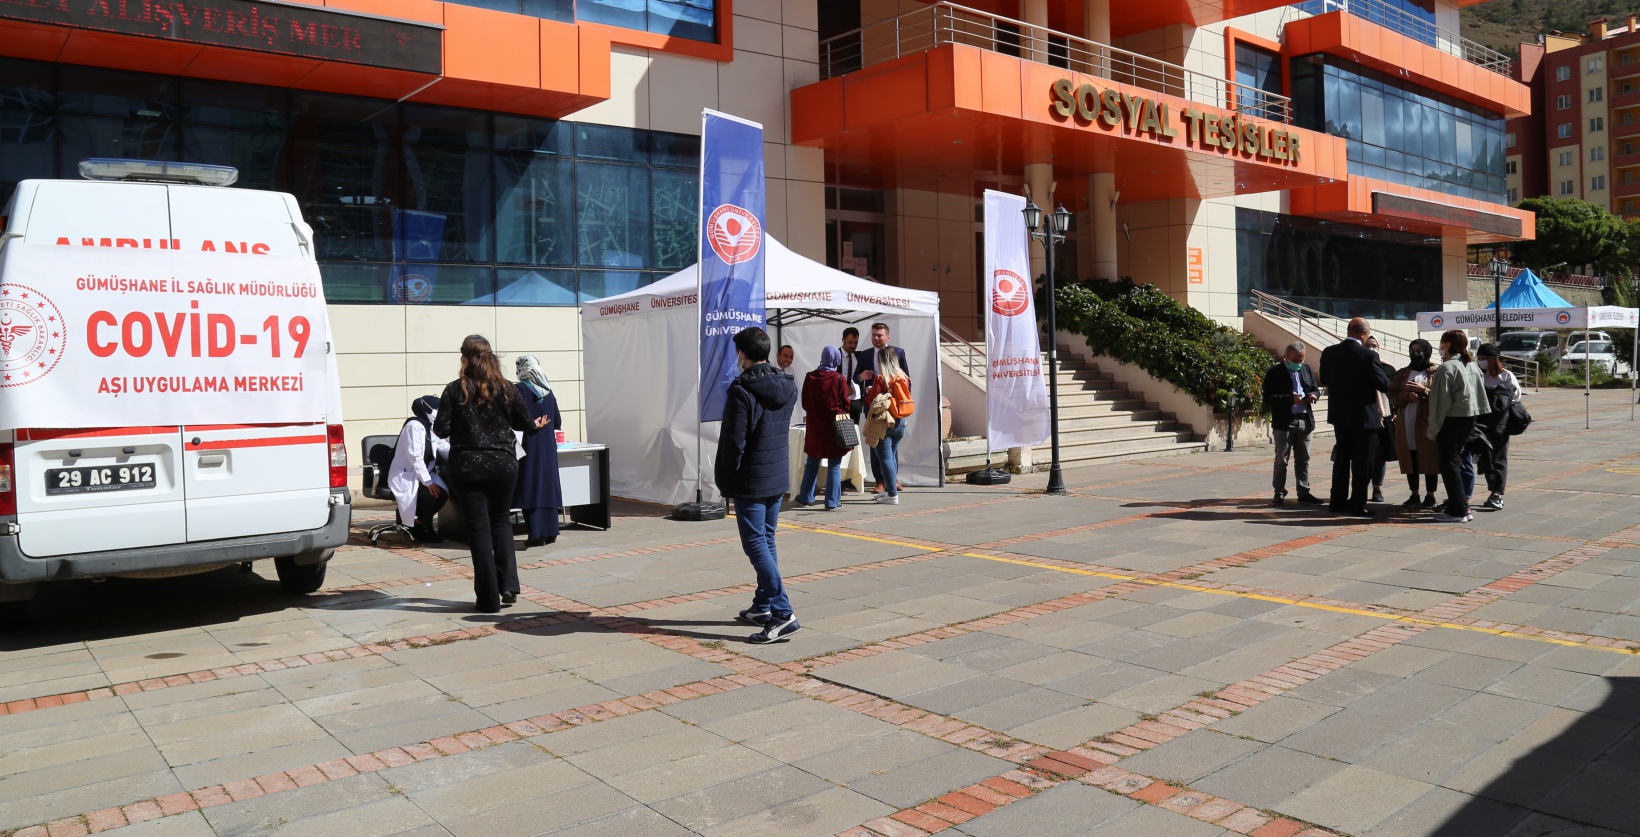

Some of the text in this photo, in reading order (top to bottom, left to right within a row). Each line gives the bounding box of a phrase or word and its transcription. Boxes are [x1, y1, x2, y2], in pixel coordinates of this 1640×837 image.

[1049, 79, 1302, 163] SOSYAL TESİSLER
[76, 275, 317, 299] GÜMÜŞHANE İL SAĞLIK MÜDÜRLÜĞÜ
[599, 293, 698, 316] GÜMÜŞHANE ÜNİVERSİTES
[847, 291, 910, 308] ÜNİVERSİTESİ
[705, 308, 763, 324] GÜMÜŞHANE
[1455, 311, 1534, 325] GÜMÜŞHANE BELEDİYESİ
[86, 299, 312, 359] COVİD-19
[97, 372, 304, 398] AŞI UYGULAMA MERKEZİ
[58, 470, 82, 488] 29
[89, 468, 112, 486] AC
[119, 466, 153, 484] 912
